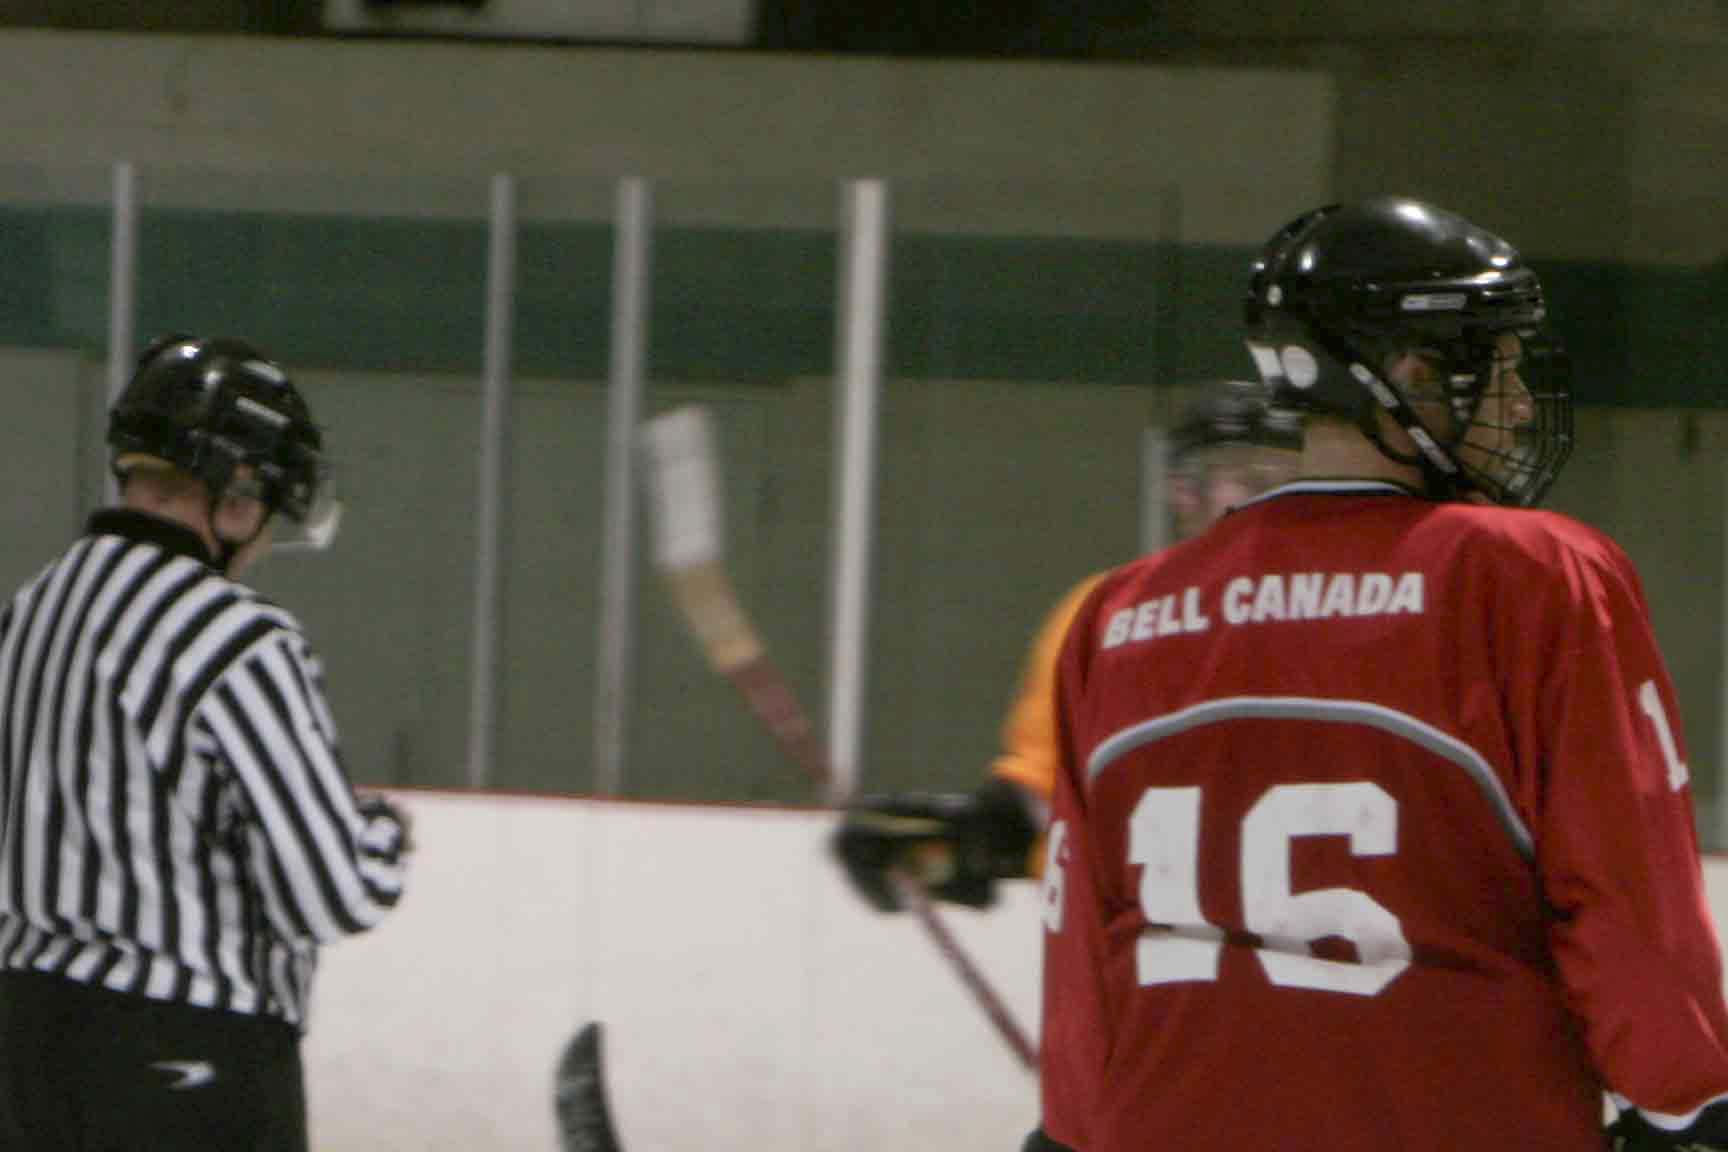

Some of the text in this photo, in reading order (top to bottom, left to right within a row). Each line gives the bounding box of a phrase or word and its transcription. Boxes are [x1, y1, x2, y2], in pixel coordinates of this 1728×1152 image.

[1102, 572, 1425, 650] BELL CANADA
[1128, 782, 1413, 996] 16
